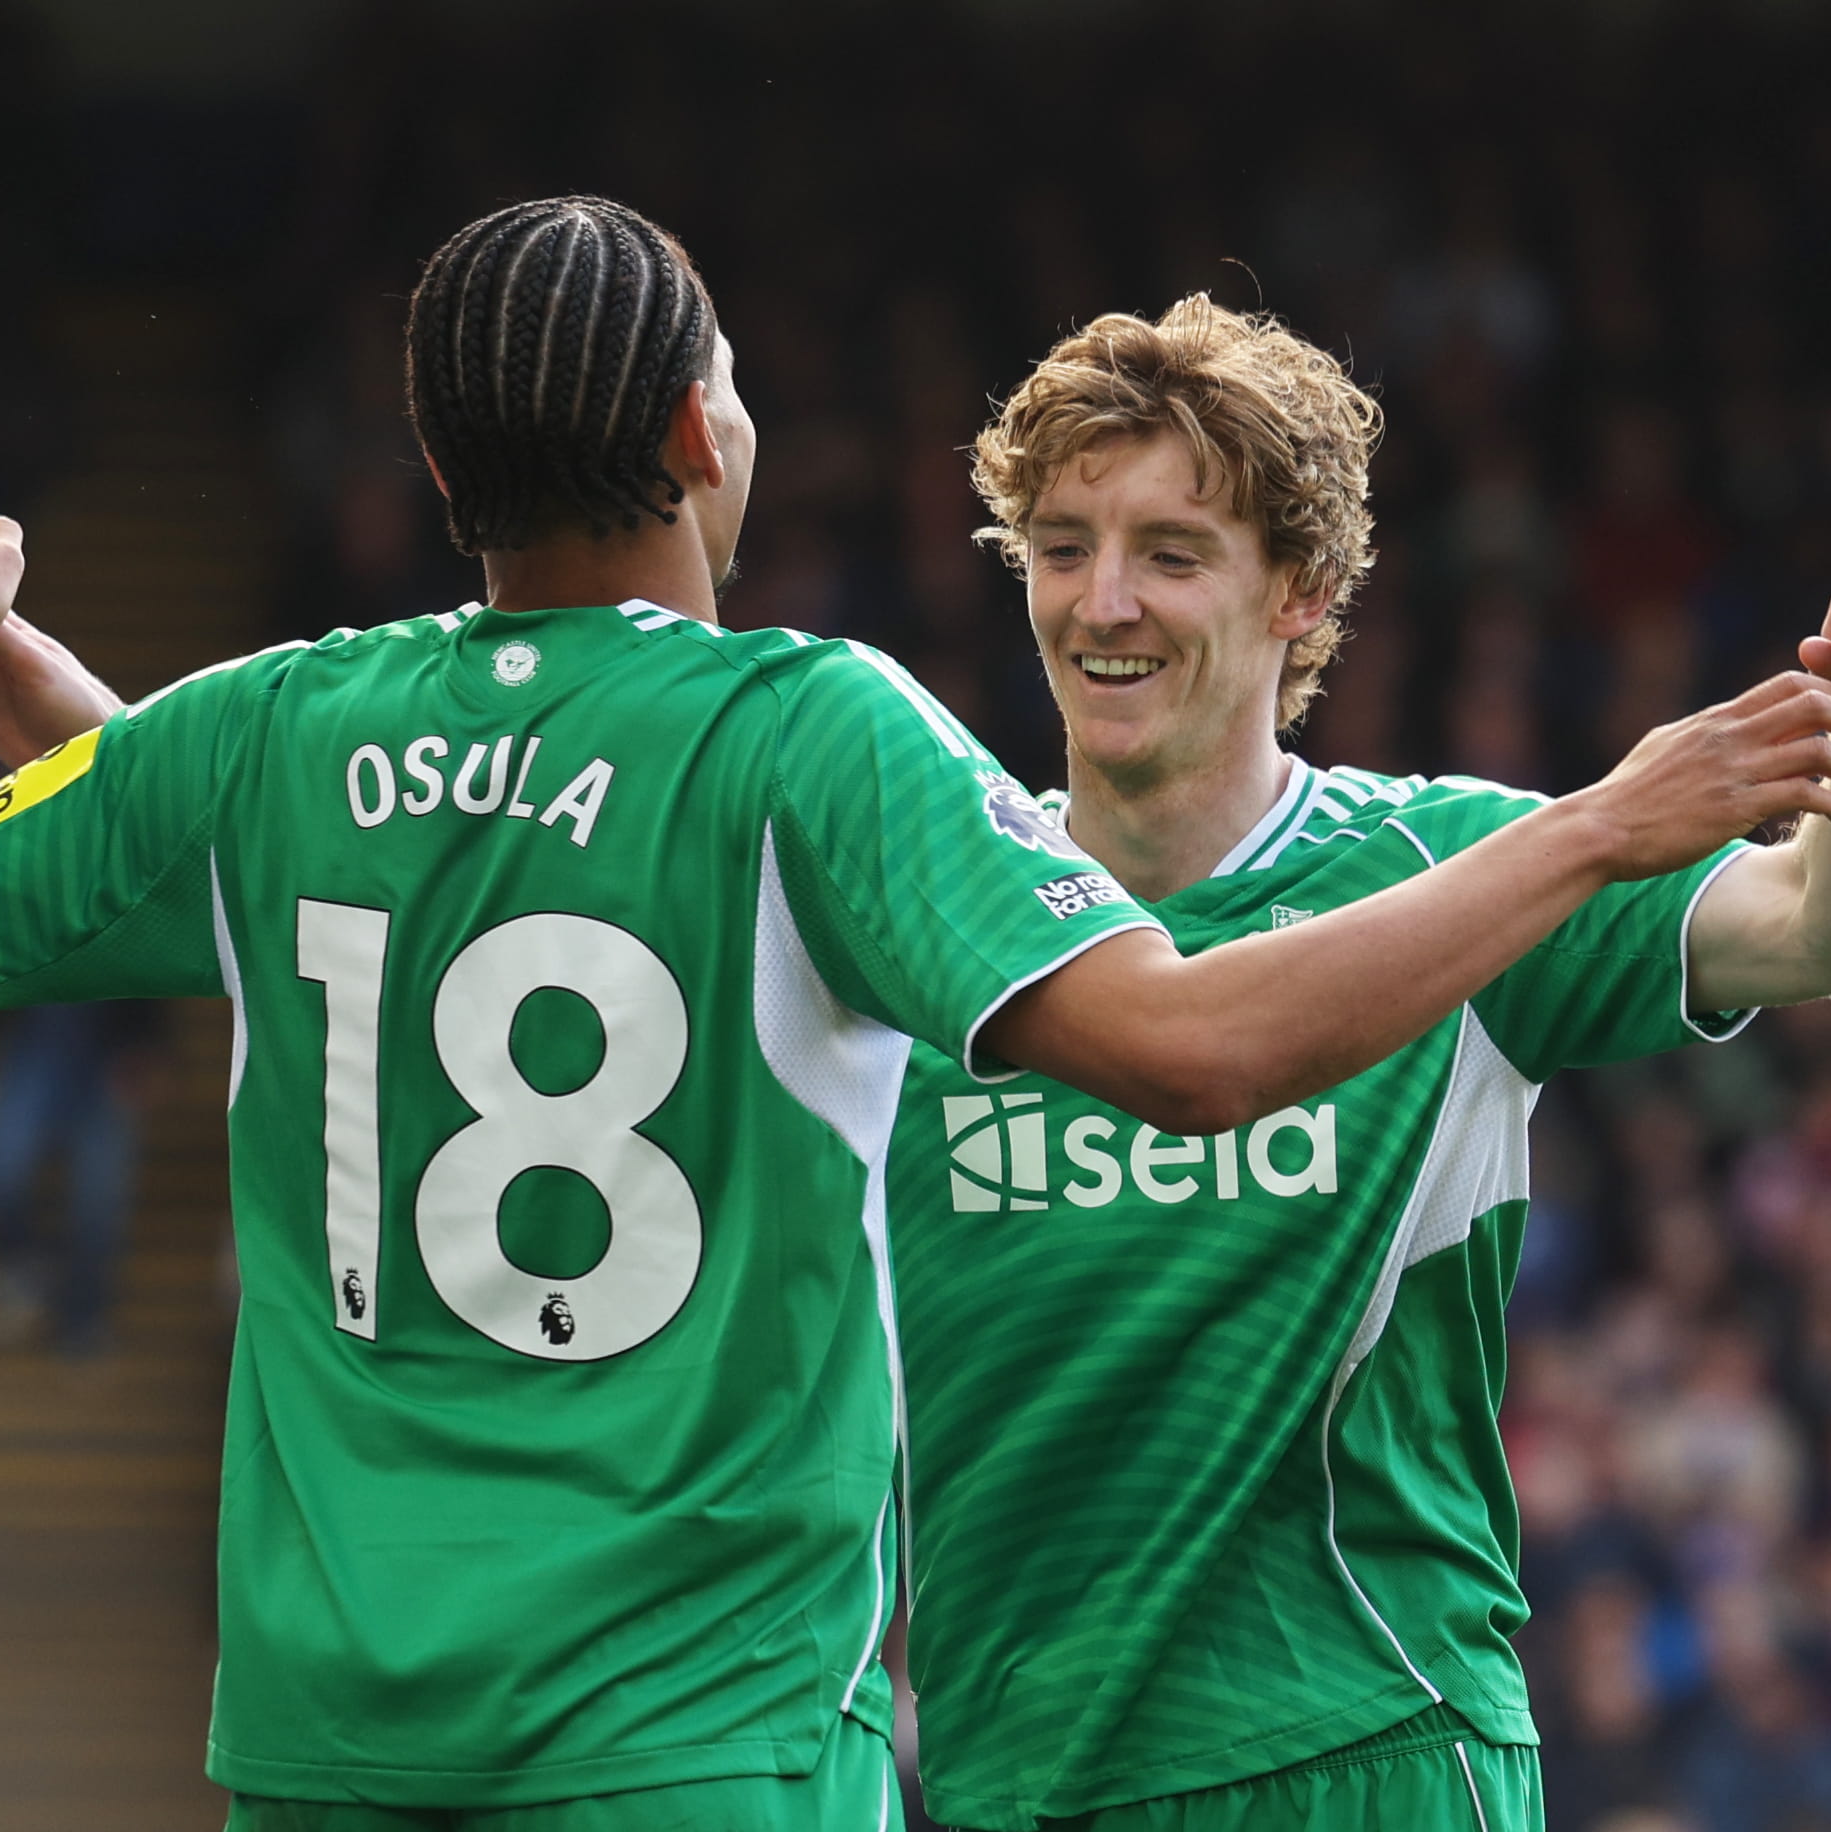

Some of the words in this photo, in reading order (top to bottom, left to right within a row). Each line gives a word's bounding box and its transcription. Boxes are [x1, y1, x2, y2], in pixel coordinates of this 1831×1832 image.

[346, 734, 617, 849] OSULA
[1034, 881, 1078, 906] No
[296, 898, 703, 1362] 18
